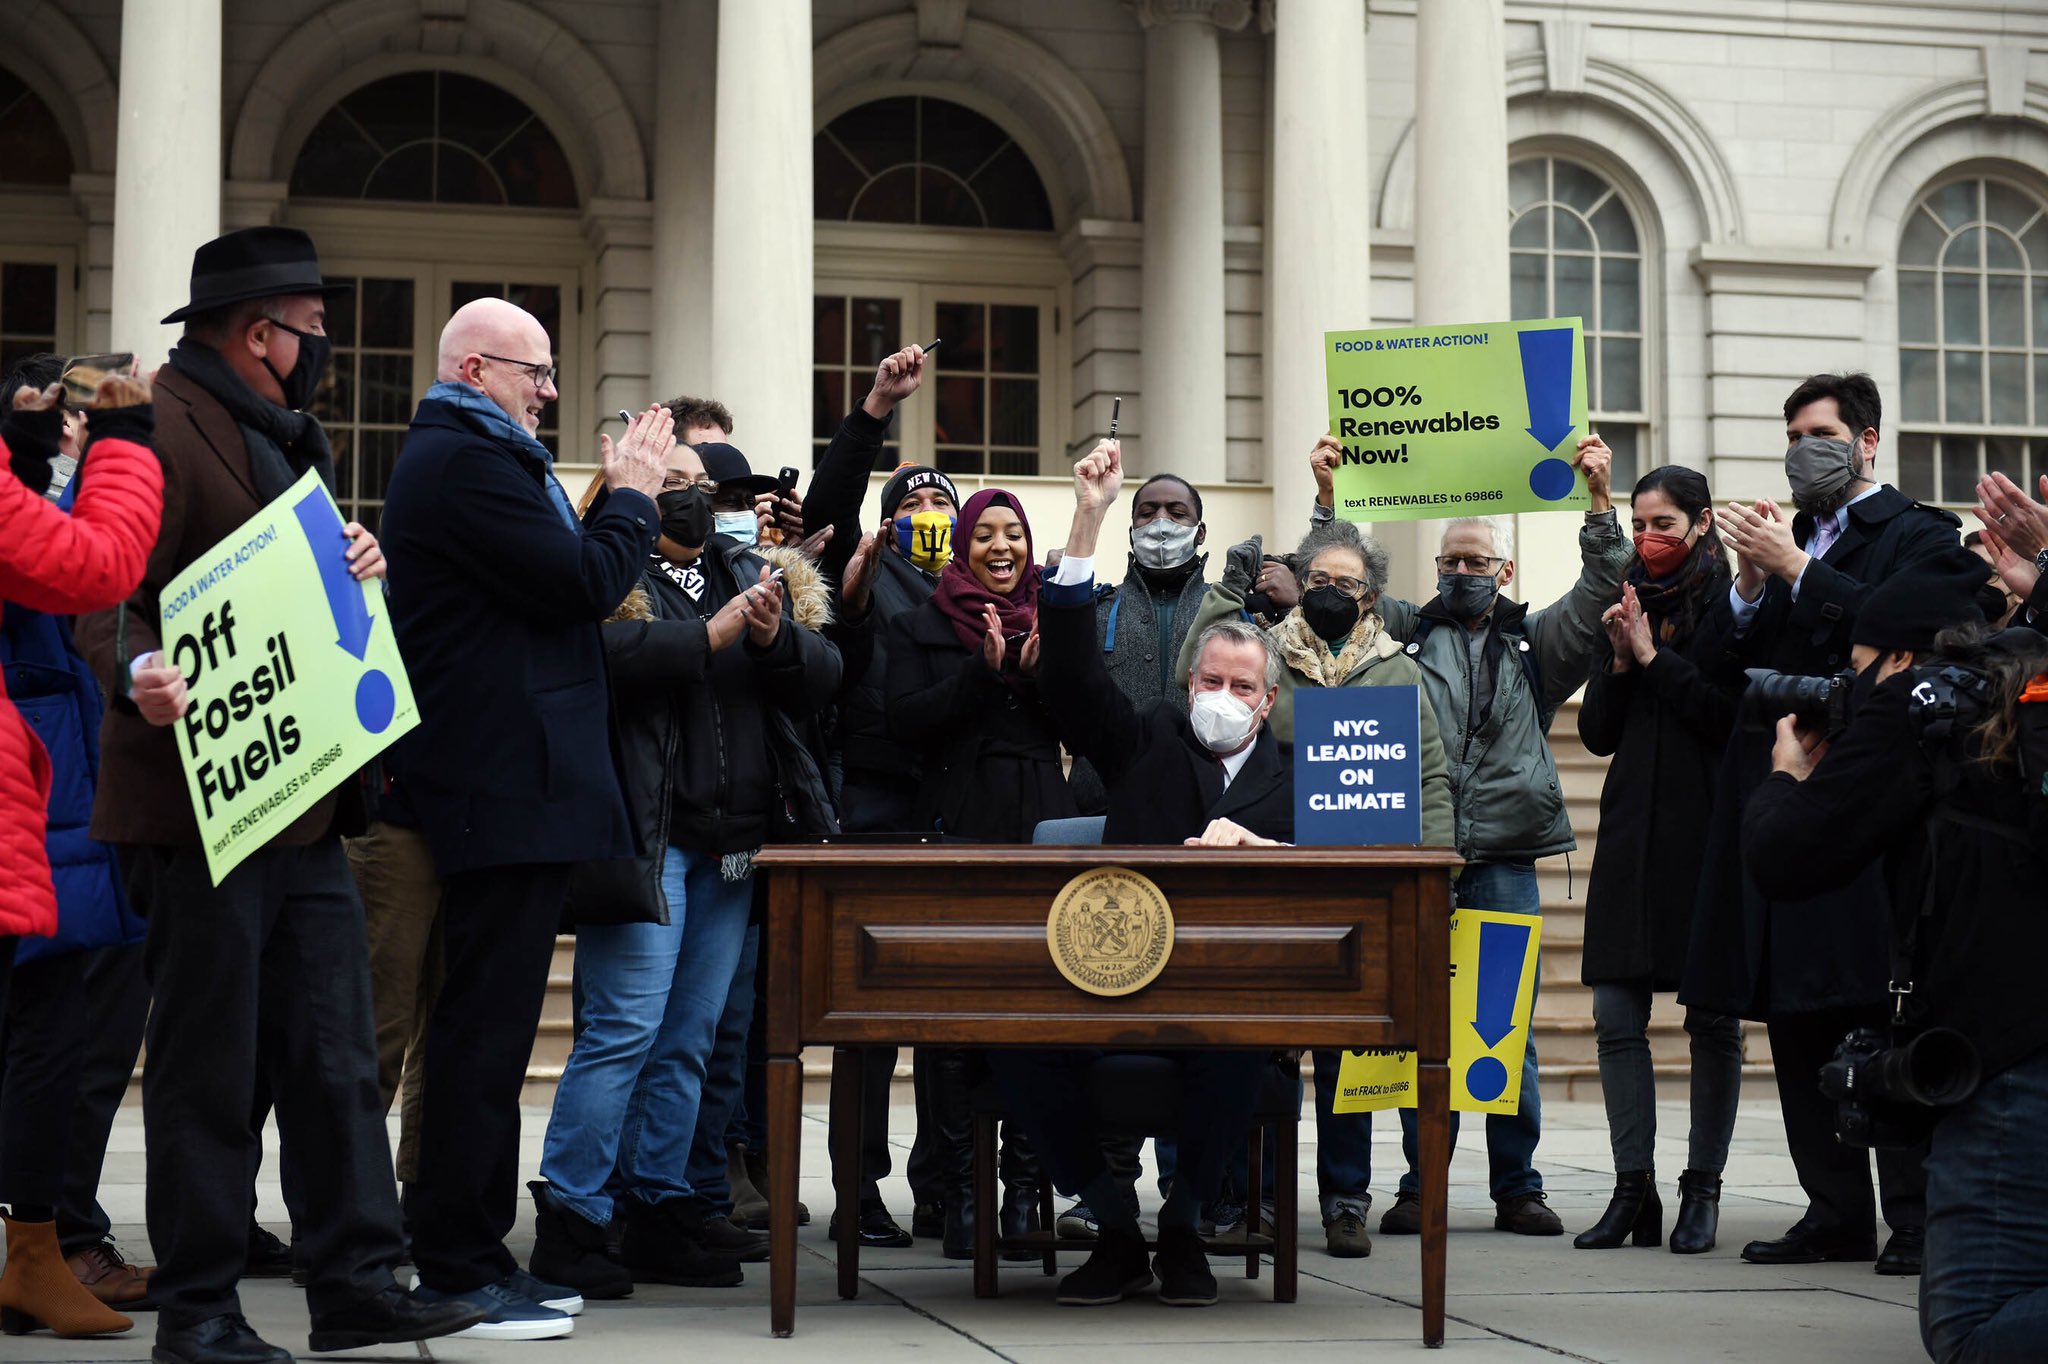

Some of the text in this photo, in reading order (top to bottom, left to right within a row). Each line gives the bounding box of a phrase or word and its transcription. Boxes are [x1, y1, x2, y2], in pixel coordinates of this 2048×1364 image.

[1335, 333, 1488, 352] FOOD & WATER ACTION!
[1338, 385, 1422, 409] 100%
[1340, 411, 1500, 437] Renewables
[1342, 443, 1408, 465] Now!
[907, 472, 930, 491] NEW
[1344, 490, 1503, 507] text RENEWABLES to 69866
[163, 524, 278, 622] FOOD & WATER ACTION!
[173, 600, 236, 690] Off
[184, 631, 296, 759] Fossil
[1333, 719, 1379, 737] NYC
[1307, 743, 1406, 762] LEADING
[196, 713, 301, 820] Fuels
[1339, 769, 1374, 786] ON
[212, 743, 343, 856] text RENEWABLES to 69866
[1309, 792, 1406, 811] CLIMATE
[1343, 1081, 1409, 1097] text FRACK to 69866
